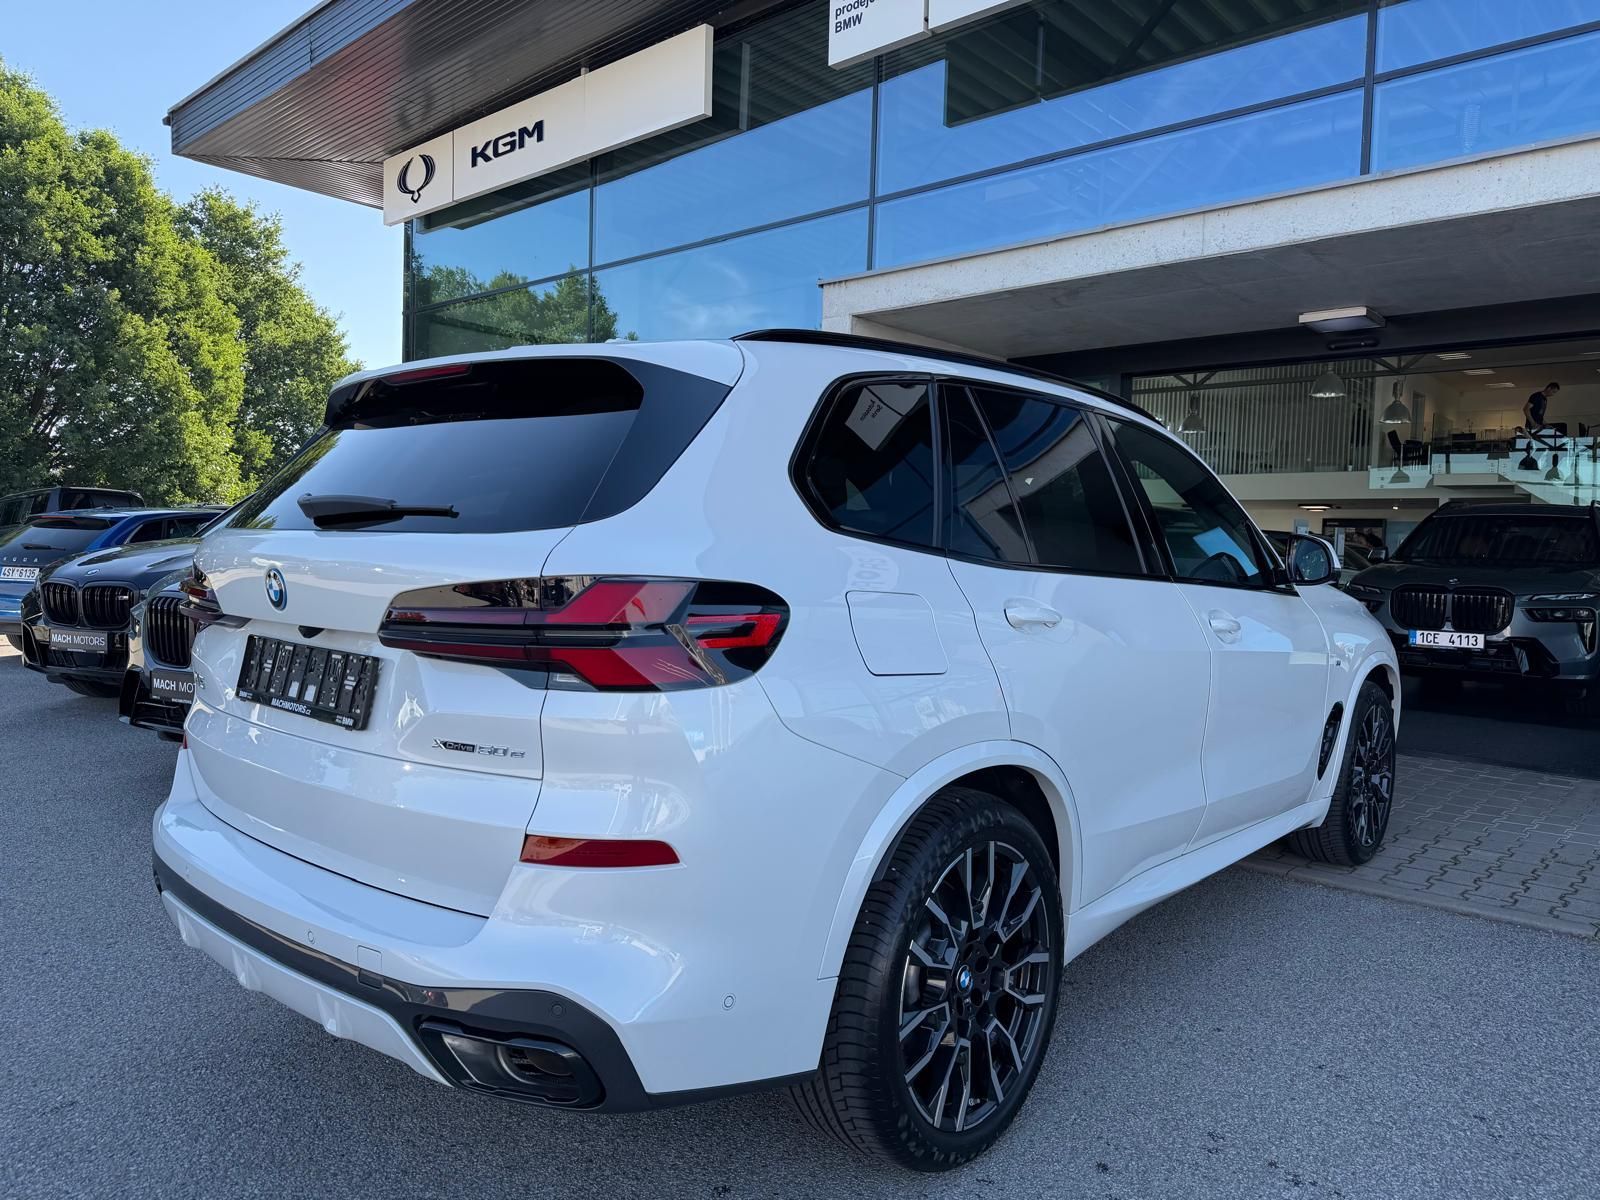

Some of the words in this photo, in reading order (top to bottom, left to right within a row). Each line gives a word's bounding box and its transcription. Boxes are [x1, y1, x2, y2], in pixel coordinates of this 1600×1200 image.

[835, 12, 863, 33] BMW
[471, 119, 544, 168] KGM
[2, 567, 16, 577] 4SY
[19, 568, 36, 578] 6135
[51, 633, 72, 644] MACH
[73, 635, 105, 646] MOTORS
[1419, 631, 1440, 644] 1CE
[1448, 633, 1478, 646] 4113
[153, 678, 176, 691] MACH
